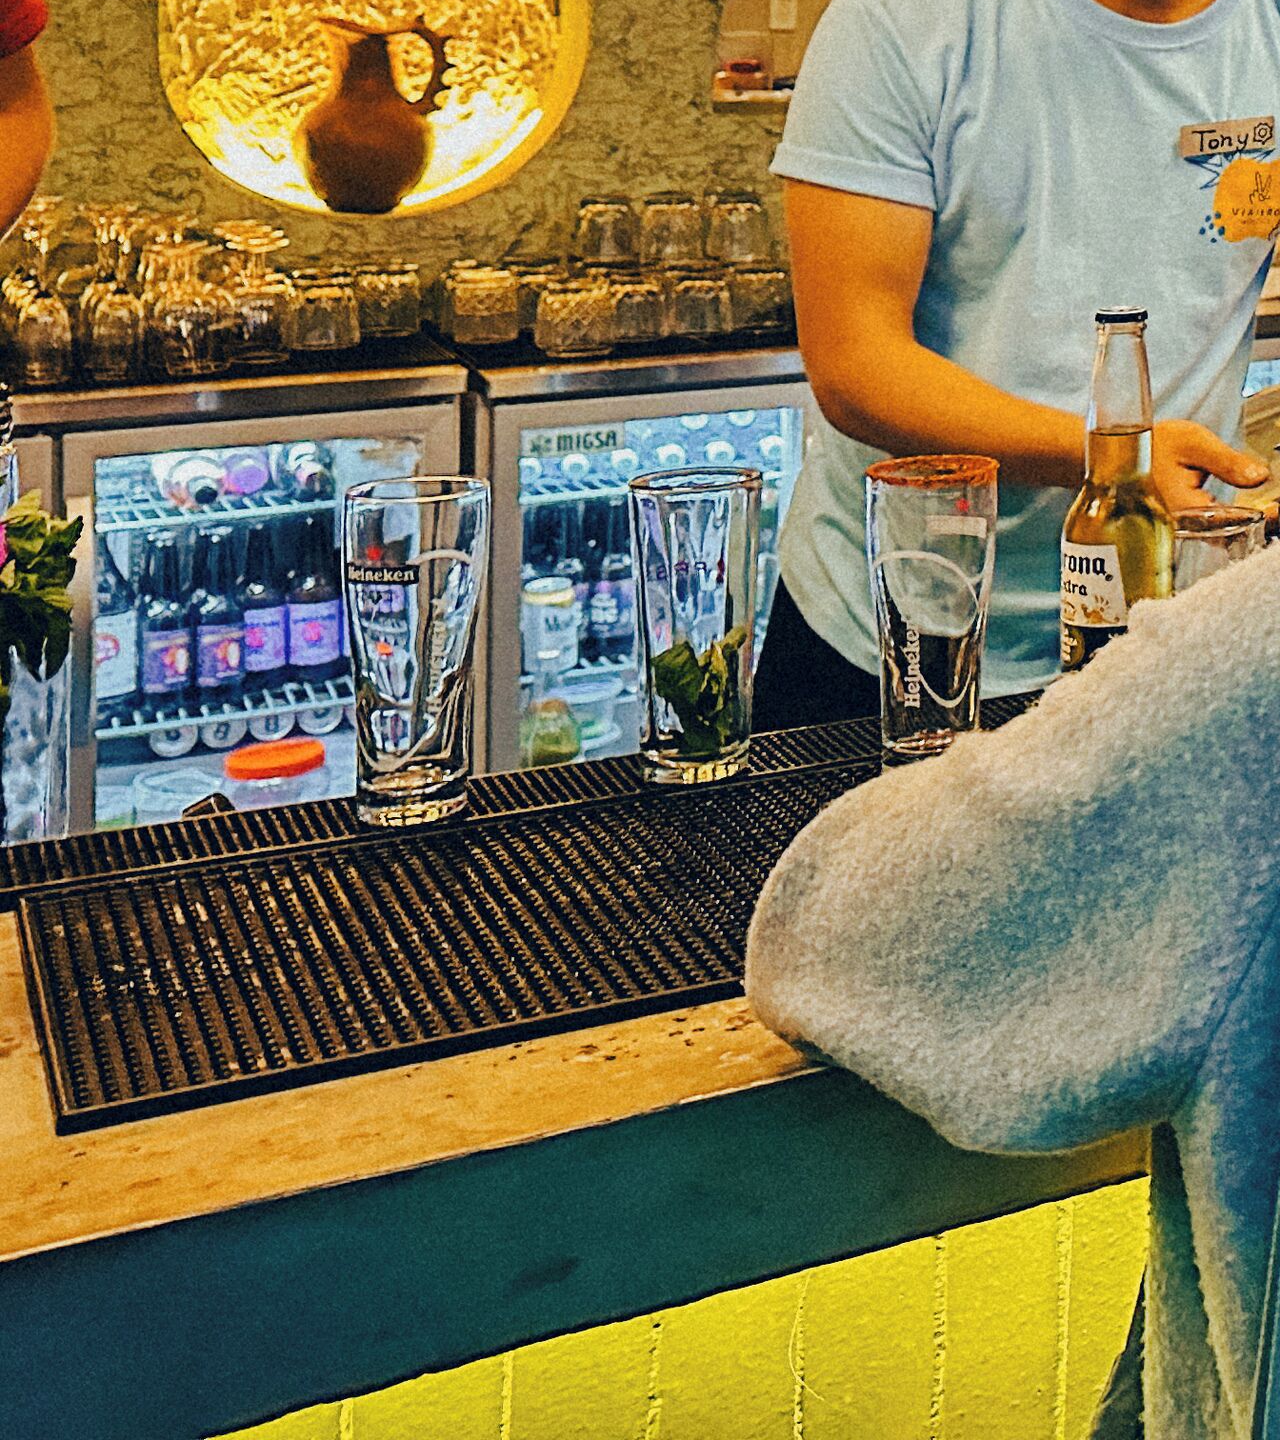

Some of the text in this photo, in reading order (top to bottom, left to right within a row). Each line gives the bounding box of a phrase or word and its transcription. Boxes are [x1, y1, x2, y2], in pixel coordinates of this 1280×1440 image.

[1192, 130, 1249, 152] Tony
[556, 428, 618, 453] MIGSA
[347, 565, 415, 582] Heineken
[1063, 553, 1107, 576] rona
[1062, 579, 1088, 596] xtra
